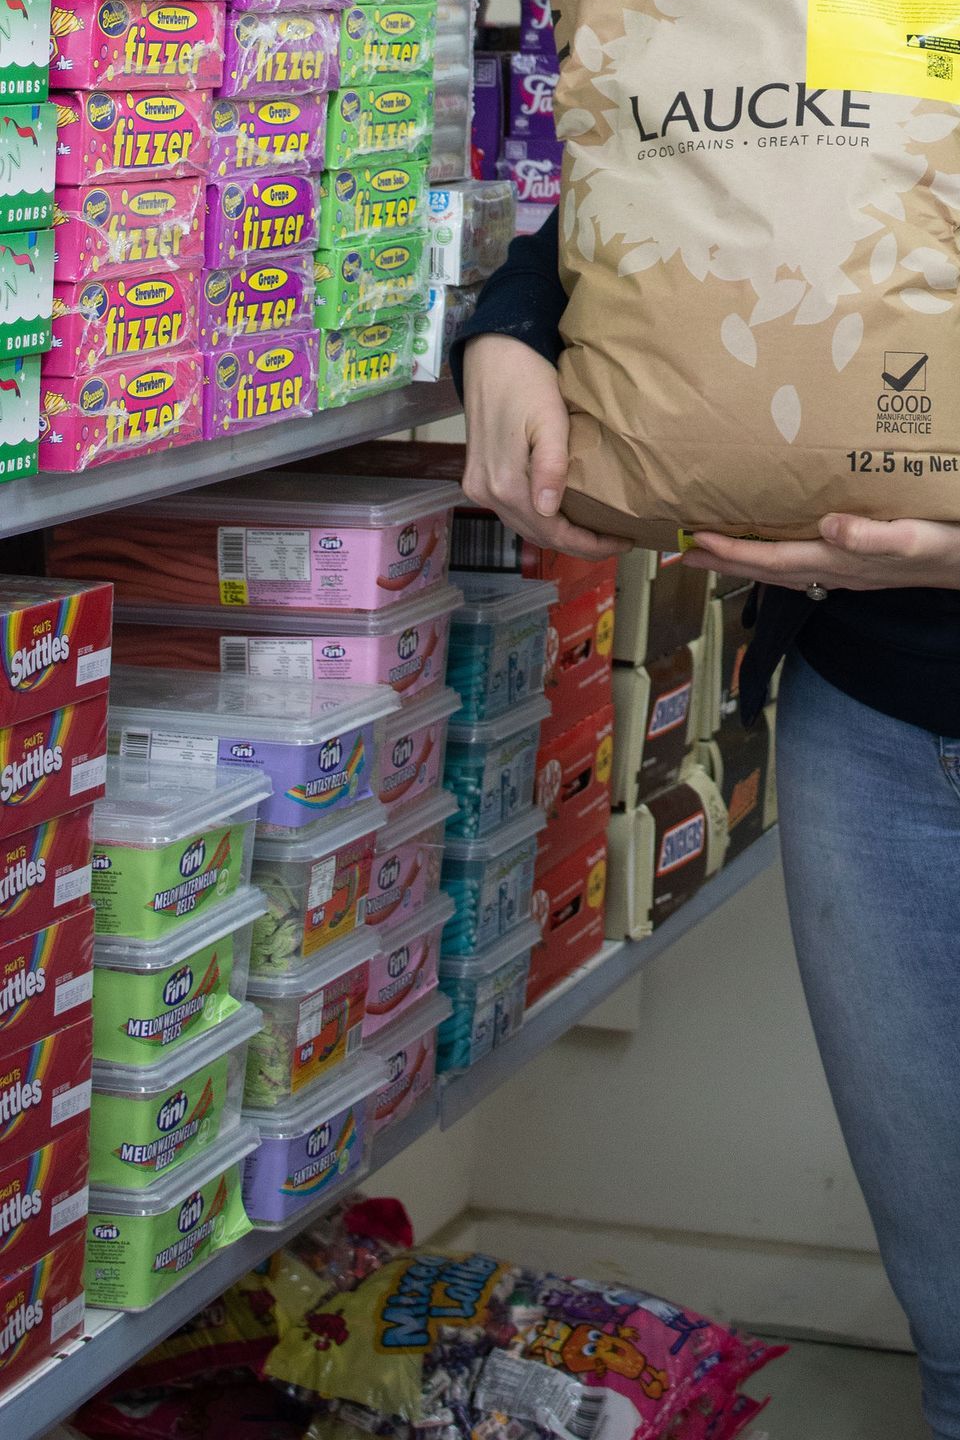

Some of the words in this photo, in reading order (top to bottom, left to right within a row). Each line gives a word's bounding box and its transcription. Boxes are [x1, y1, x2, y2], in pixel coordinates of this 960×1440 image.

[157, 11, 190, 30] Strawberry
[123, 25, 205, 75] fizzer
[0, 78, 41, 96] BOMBS
[144, 99, 179, 120] Strawberry
[268, 105, 291, 121] Grape
[629, 82, 872, 143] LAUCKE
[112, 116, 193, 168] fizzer
[637, 145, 675, 161] GOOD
[678, 138, 735, 154] GRAINS
[757, 135, 809, 148] GREAT
[817, 135, 870, 148] FLOUR
[269, 188, 290, 202] Grape
[8, 204, 48, 222] BOMBS
[354, 190, 417, 232] fizzer
[105, 213, 184, 264] fizzer
[242, 205, 305, 251] fizzer
[134, 284, 168, 303] Strawberry
[258, 272, 279, 286] Grape
[226, 291, 296, 337] fizzer
[6, 330, 47, 351] BOMBS
[104, 305, 184, 357] fizzer
[265, 353, 286, 367] Grape
[135, 375, 168, 395] Strawberry
[236, 374, 303, 420] fizzer
[876, 413, 932, 422] MANUFACTURING
[877, 394, 932, 413] GOOD
[105, 398, 182, 449] fizzer
[876, 421, 932, 435] PRACTICE
[846, 450, 896, 473] 12.5
[903, 456, 924, 477] kg
[930, 456, 959, 472] Net
[321, 536, 342, 550] Fini
[11, 633, 70, 688] Skittles
[323, 645, 345, 659] Fini
[231, 744, 252, 758] Fini
[320, 740, 341, 772] Fini
[0, 745, 63, 802] Skittles
[181, 843, 204, 875] Fini
[155, 884, 179, 911] MELON
[178, 868, 218, 899] WATERMELON
[176, 893, 197, 917] BELTS
[165, 972, 191, 1004] Fini
[128, 1009, 165, 1037] MELON
[163, 994, 204, 1026] WATERMELON
[161, 1021, 182, 1046] BELTS
[159, 1096, 187, 1130] Fini
[121, 1140, 157, 1162] MELON
[155, 1120, 199, 1157] WATERMELON
[308, 1122, 331, 1156] Fini
[179, 1199, 202, 1231] Fini
[95, 1226, 117, 1239] Fini
[155, 1241, 178, 1270] MELON
[381, 1254, 449, 1348] Mixed
